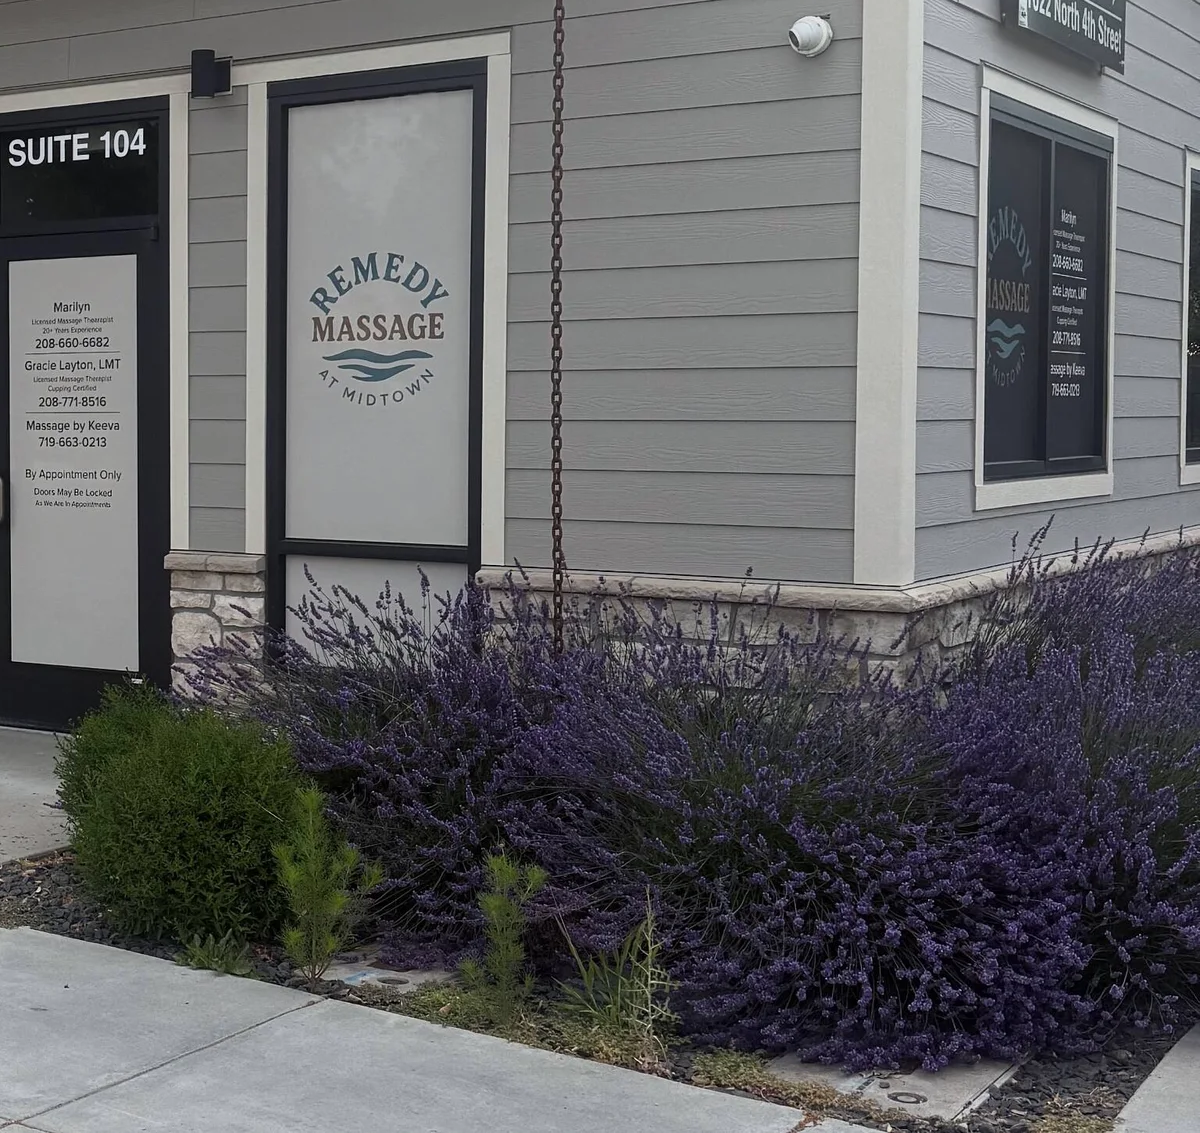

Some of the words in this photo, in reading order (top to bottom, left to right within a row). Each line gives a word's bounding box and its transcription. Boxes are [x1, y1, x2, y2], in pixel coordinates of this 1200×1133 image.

[1082, 7, 1096, 41] 4th
[1098, 15, 1122, 55] Street
[8, 132, 90, 167] SUITE
[100, 128, 147, 158] 104
[309, 252, 450, 315] REMEDY
[53, 302, 91, 314] Marilyn
[312, 313, 445, 342] MASSAGE
[35, 337, 110, 349] 208-660-6682
[24, 360, 57, 371] Gracie
[59, 359, 96, 372] Layton,
[99, 358, 121, 370] LMT
[318, 369, 339, 388] AT
[342, 368, 435, 406] MIDTOWN
[38, 396, 107, 407] 208-771-8516
[26, 420, 70, 433] Massage
[73, 420, 86, 433] by
[88, 420, 120, 431] Keeva
[38, 436, 107, 447] 719-663-0213
[25, 468, 37, 481] By
[39, 469, 97, 481] Appointment
[100, 469, 122, 482] Only
[33, 487, 56, 496] Doors
[57, 488, 72, 498] May
[74, 488, 84, 496] Be
[85, 489, 113, 497] Locked
